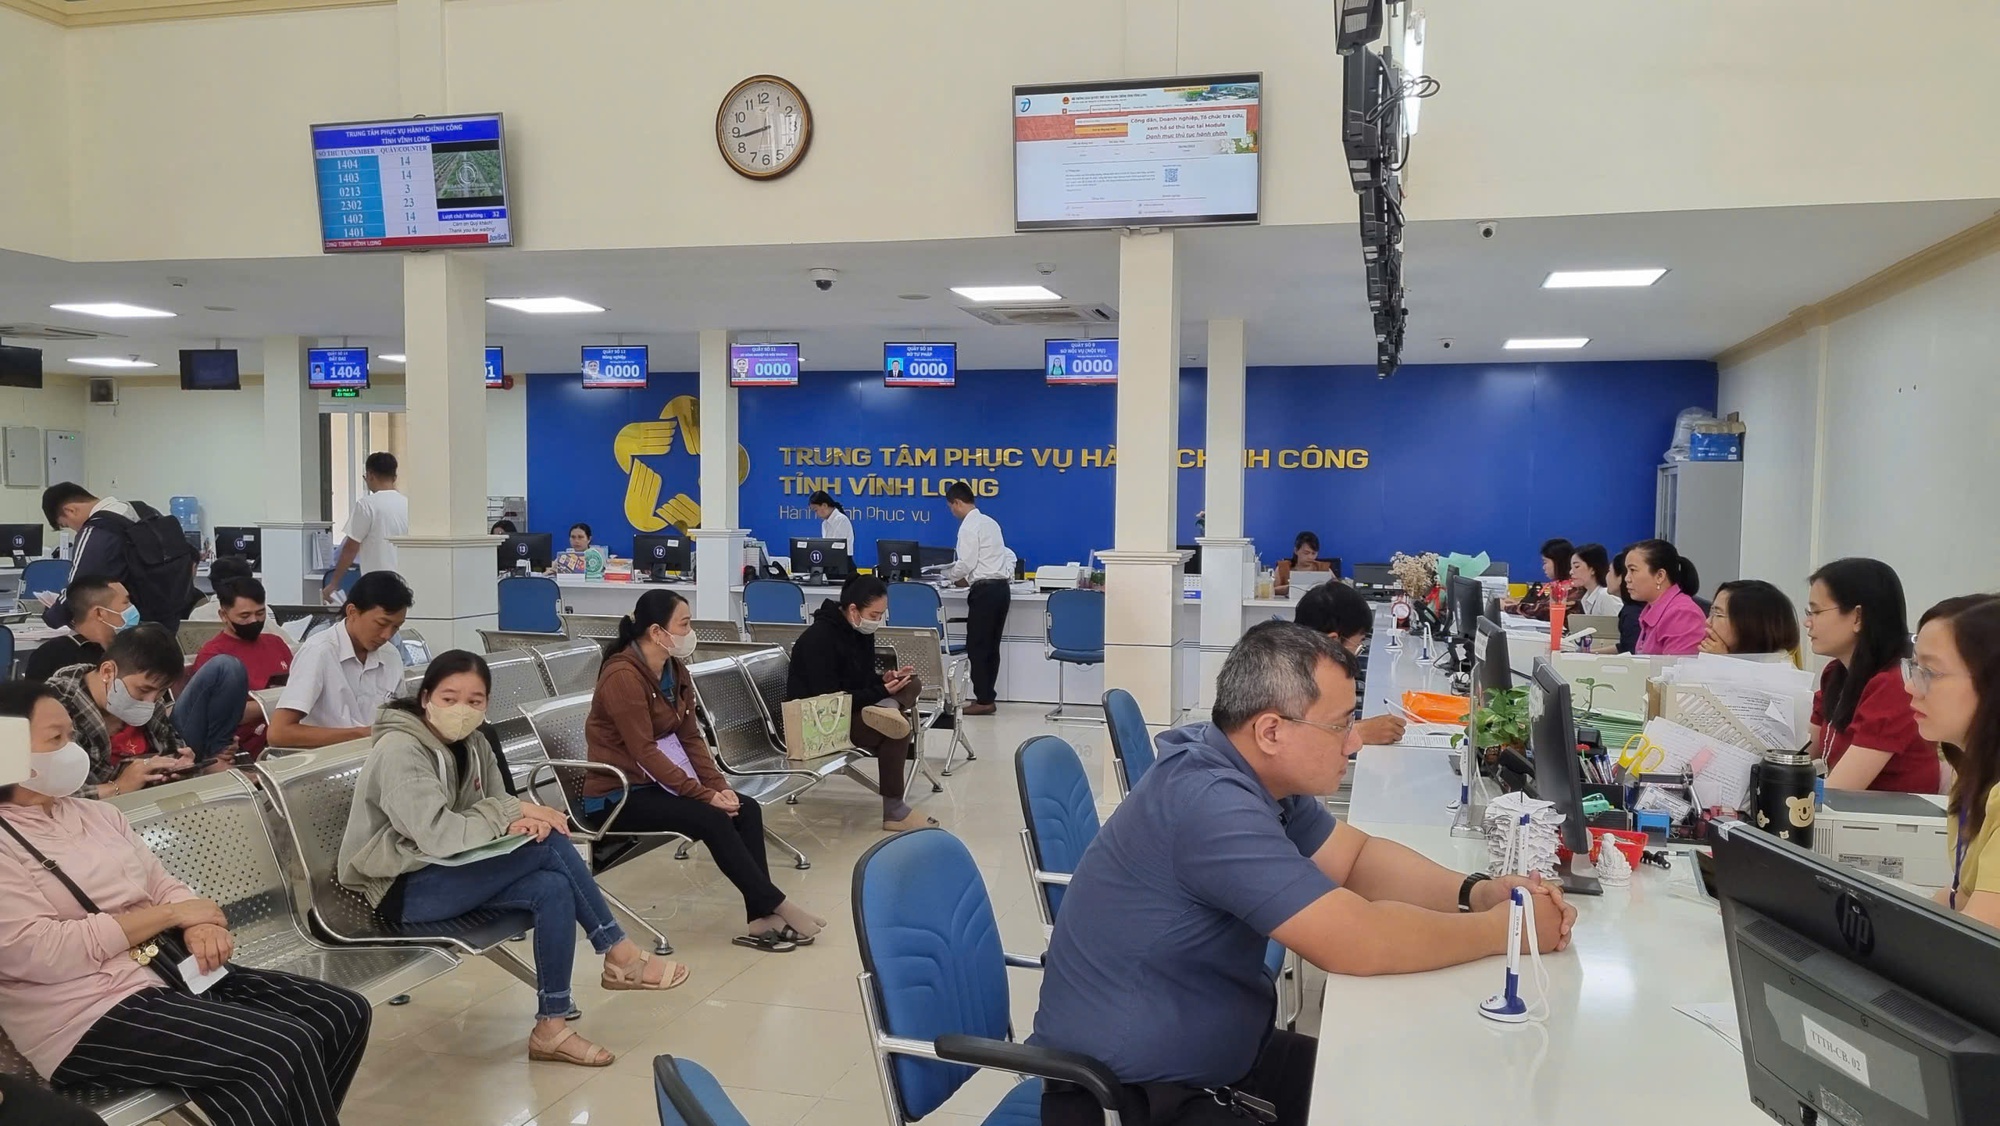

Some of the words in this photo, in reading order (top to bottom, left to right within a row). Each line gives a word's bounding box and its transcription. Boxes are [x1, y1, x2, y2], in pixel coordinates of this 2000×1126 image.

[757, 92, 770, 104] 12
[776, 96, 781, 107] 1
[745, 99, 754, 110] 11
[734, 111, 746, 123] 10
[784, 106, 793, 117] 2
[367, 128, 380, 136] TÂM
[380, 128, 397, 137] PHỤC
[406, 126, 424, 134] HÀNH
[425, 124, 445, 132] CHÍNH
[446, 123, 463, 131] CÔNG
[732, 127, 741, 138] 9
[414, 135, 430, 143] LONG
[738, 142, 746, 154] 8
[750, 152, 758, 162] 7
[762, 154, 770, 166] 6
[776, 150, 784, 160] 5
[337, 160, 358, 170] 1404
[400, 156, 410, 166] 14
[338, 173, 360, 184] 1403
[402, 170, 412, 180] 14
[340, 186, 361, 197] 0213
[405, 184, 410, 194] 3
[340, 200, 362, 210] 2302
[404, 198, 414, 208] 23
[342, 214, 364, 224] 1402
[406, 212, 416, 222] 14
[344, 228, 364, 238] 1401
[407, 226, 417, 235] 14
[605, 364, 640, 378] 0000
[755, 363, 791, 376] 0000
[910, 362, 948, 376] 0000
[1072, 359, 1112, 372] 0000
[330, 366, 361, 378] 1404
[779, 447, 872, 467] TRUNG
[878, 444, 937, 467] TÂM
[944, 447, 1024, 472] PHỤC
[1032, 448, 1074, 473] VỤ
[1081, 444, 1117, 468] HÀ
[1278, 444, 1369, 469] CÔNG
[779, 472, 842, 495] TỈNH
[848, 473, 914, 496] VĨNH
[866, 506, 905, 522] Phục
[912, 510, 930, 524] vụ
[1852, 1059, 1862, 1072] 02
